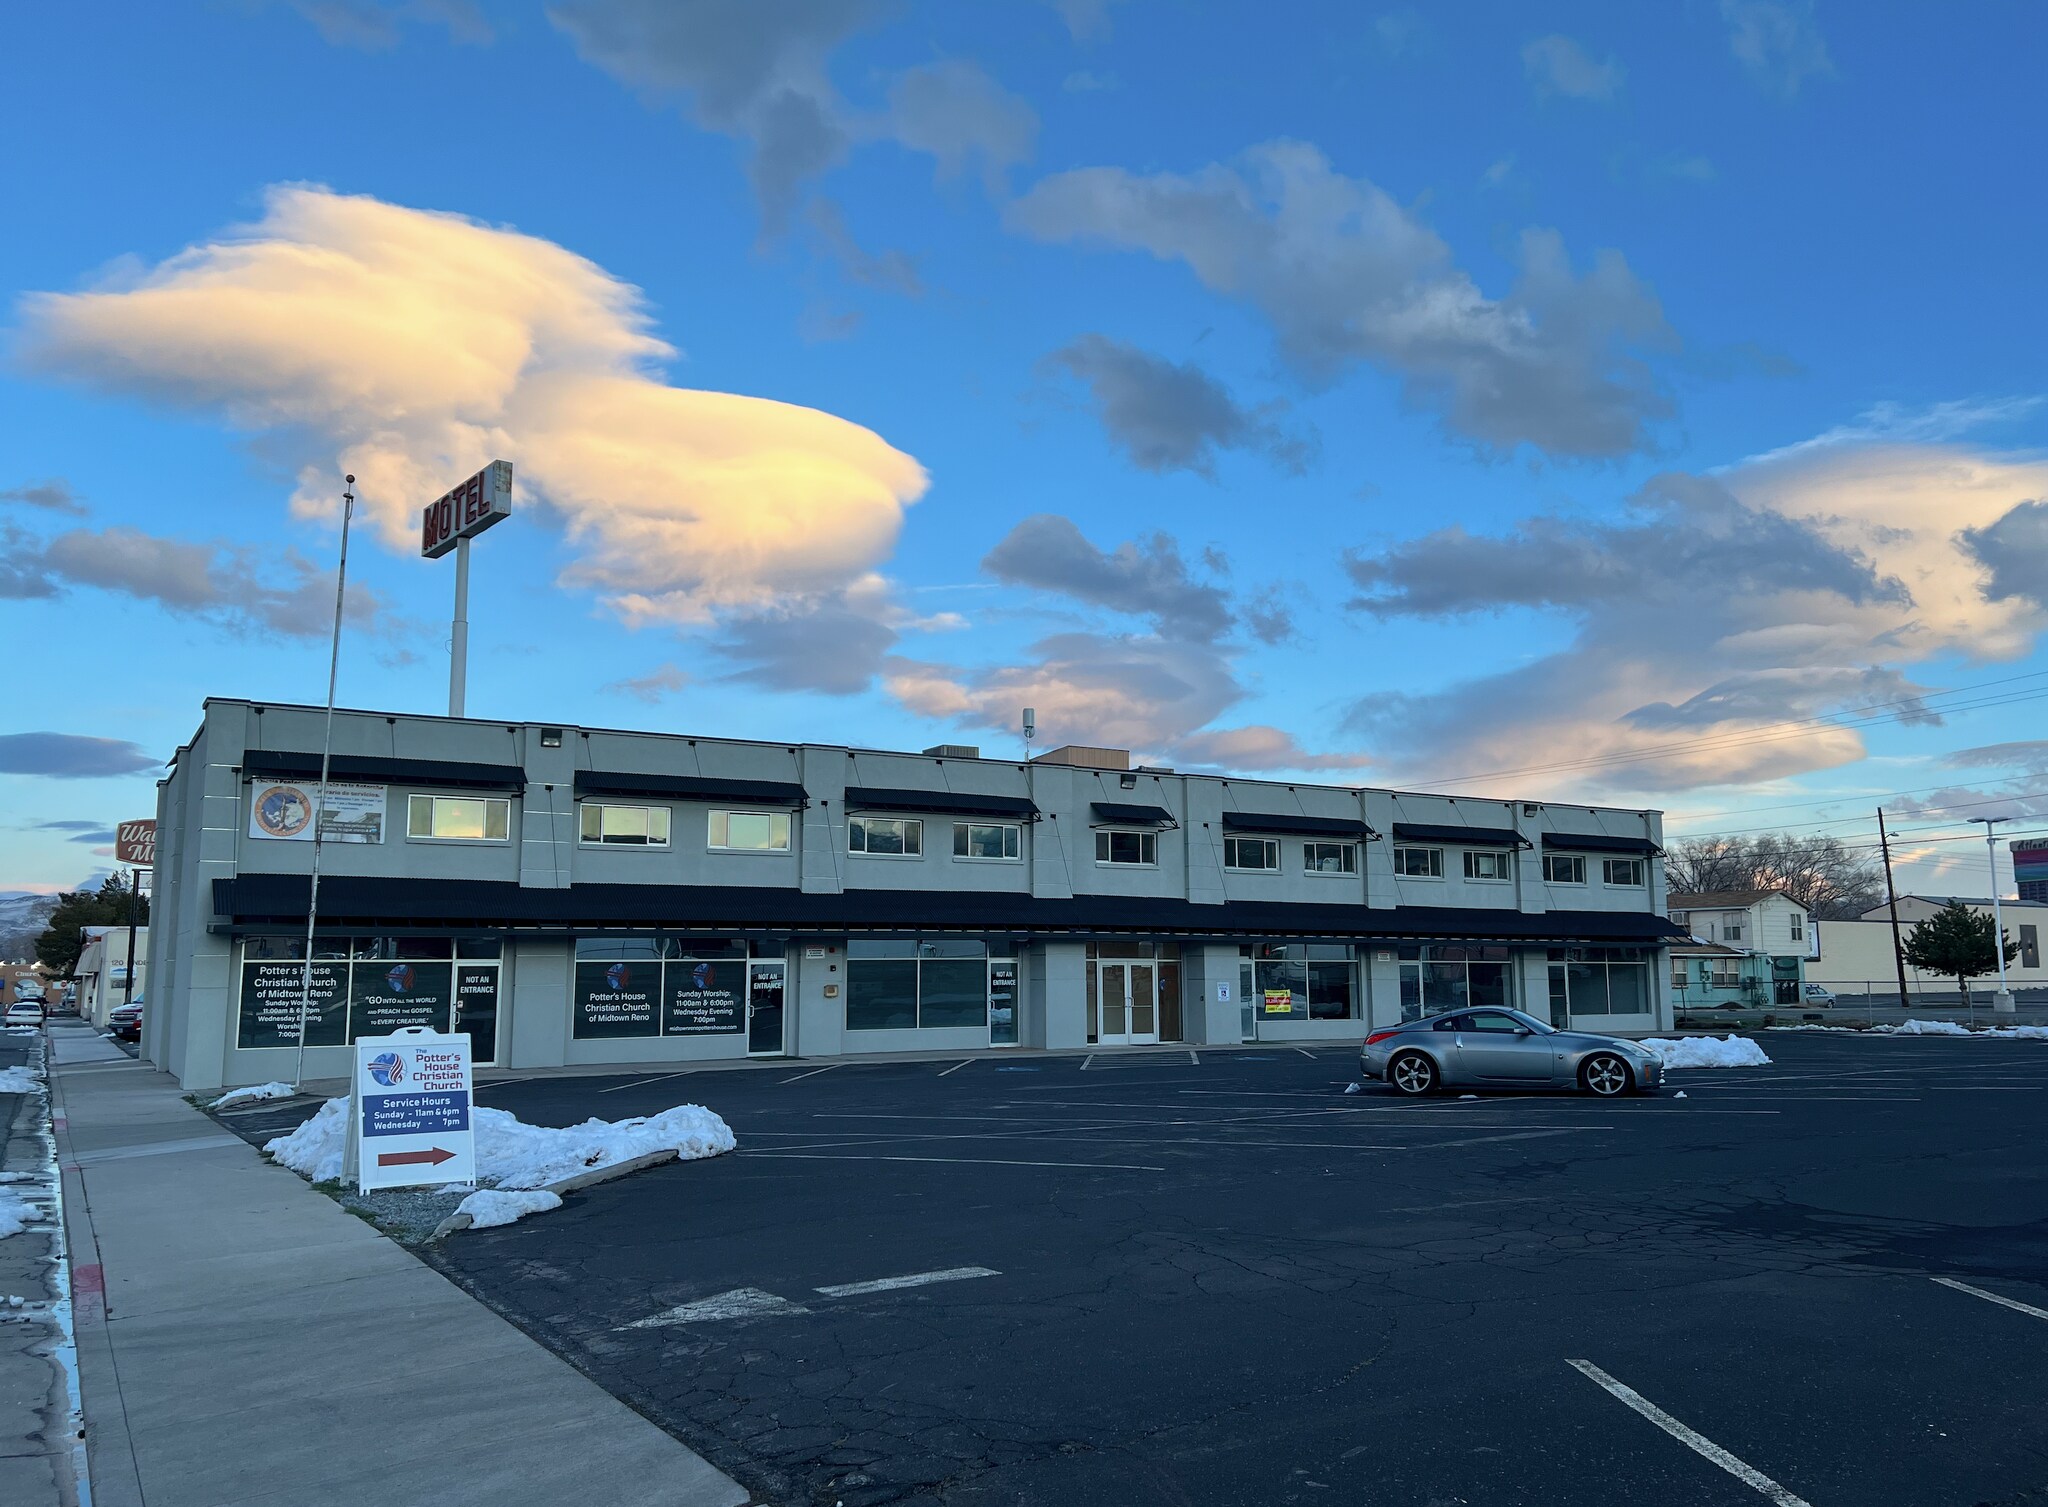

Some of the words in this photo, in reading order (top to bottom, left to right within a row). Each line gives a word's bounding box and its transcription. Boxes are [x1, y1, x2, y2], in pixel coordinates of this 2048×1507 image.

[423, 471, 490, 550] MOTEL
[254, 977, 299, 987] Christian
[753, 982, 782, 990] ENTRANCE
[256, 989, 267, 999] of
[310, 989, 333, 998] Reno
[590, 992, 619, 1001] Potter's
[621, 992, 646, 1001] House
[677, 990, 702, 998] Sunday
[585, 1003, 620, 1012] Christian
[622, 1003, 650, 1011] Church
[709, 999, 734, 1007] 6:00pm
[296, 1007, 320, 1015] 6:0pm
[673, 1008, 708, 1016] Wednesday
[709, 1008, 733, 1016] Evening
[258, 1015, 295, 1023] Wednesday
[297, 1015, 322, 1023] Eening
[588, 1014, 597, 1023] of
[598, 1014, 630, 1022] Midtown
[631, 1013, 650, 1021] Reno
[416, 1053, 461, 1063] Potter's
[424, 1062, 460, 1072] House
[412, 1071, 463, 1081] Christian
[424, 1081, 463, 1091] Church
[383, 1099, 420, 1108] Service
[422, 1097, 451, 1106] Hours
[374, 1111, 405, 1120] Sunday
[415, 1109, 434, 1117] 11am
[435, 1108, 441, 1116] &
[442, 1108, 460, 1117] 6pm
[374, 1121, 421, 1130] Wednesday
[443, 1118, 460, 1128] 7pm
